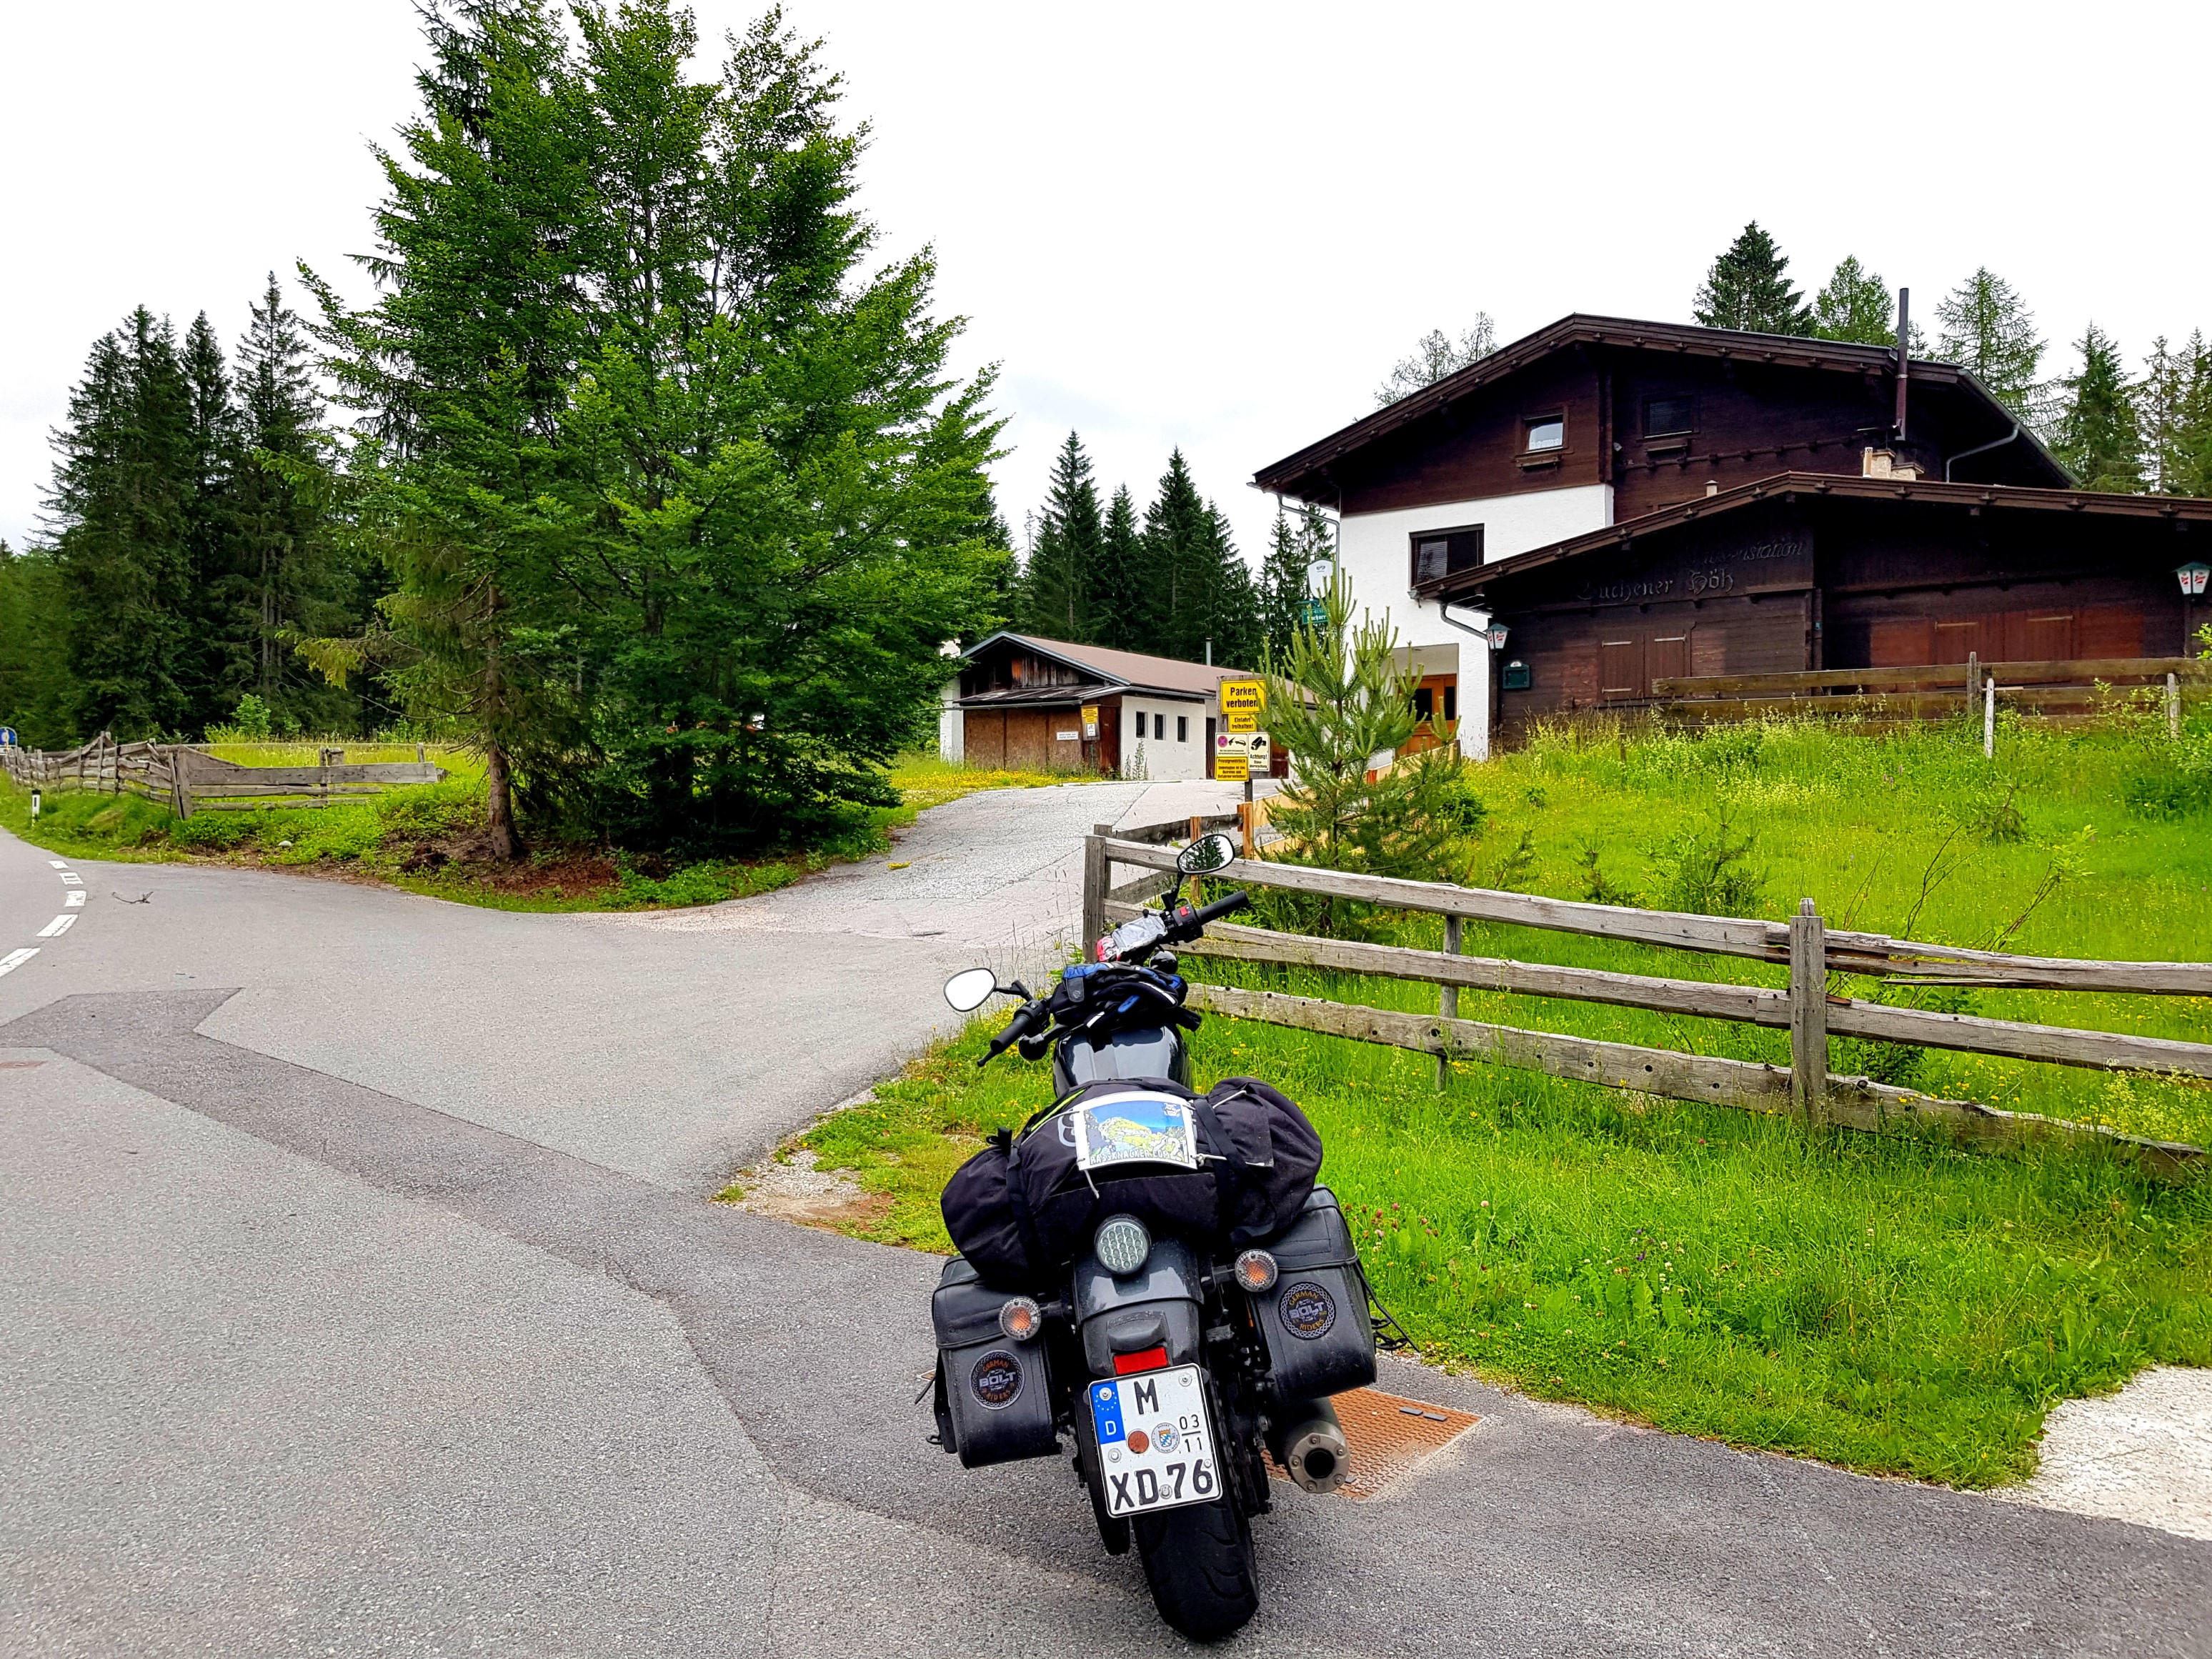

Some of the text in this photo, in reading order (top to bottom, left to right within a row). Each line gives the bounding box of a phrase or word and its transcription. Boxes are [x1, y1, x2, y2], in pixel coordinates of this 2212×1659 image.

[1230, 687, 1257, 696] Parken
[1226, 699, 1258, 708] verboten
[1289, 1290, 1319, 1306] GERMAN
[1299, 1318, 1325, 1330] RIDERS
[982, 1359, 1009, 1372] GERMAN
[979, 1372, 1016, 1388] BOLT
[1133, 1378, 1160, 1415] M
[1105, 1420, 1117, 1435] D
[1179, 1414, 1200, 1430] 03
[1185, 1437, 1202, 1453] 11
